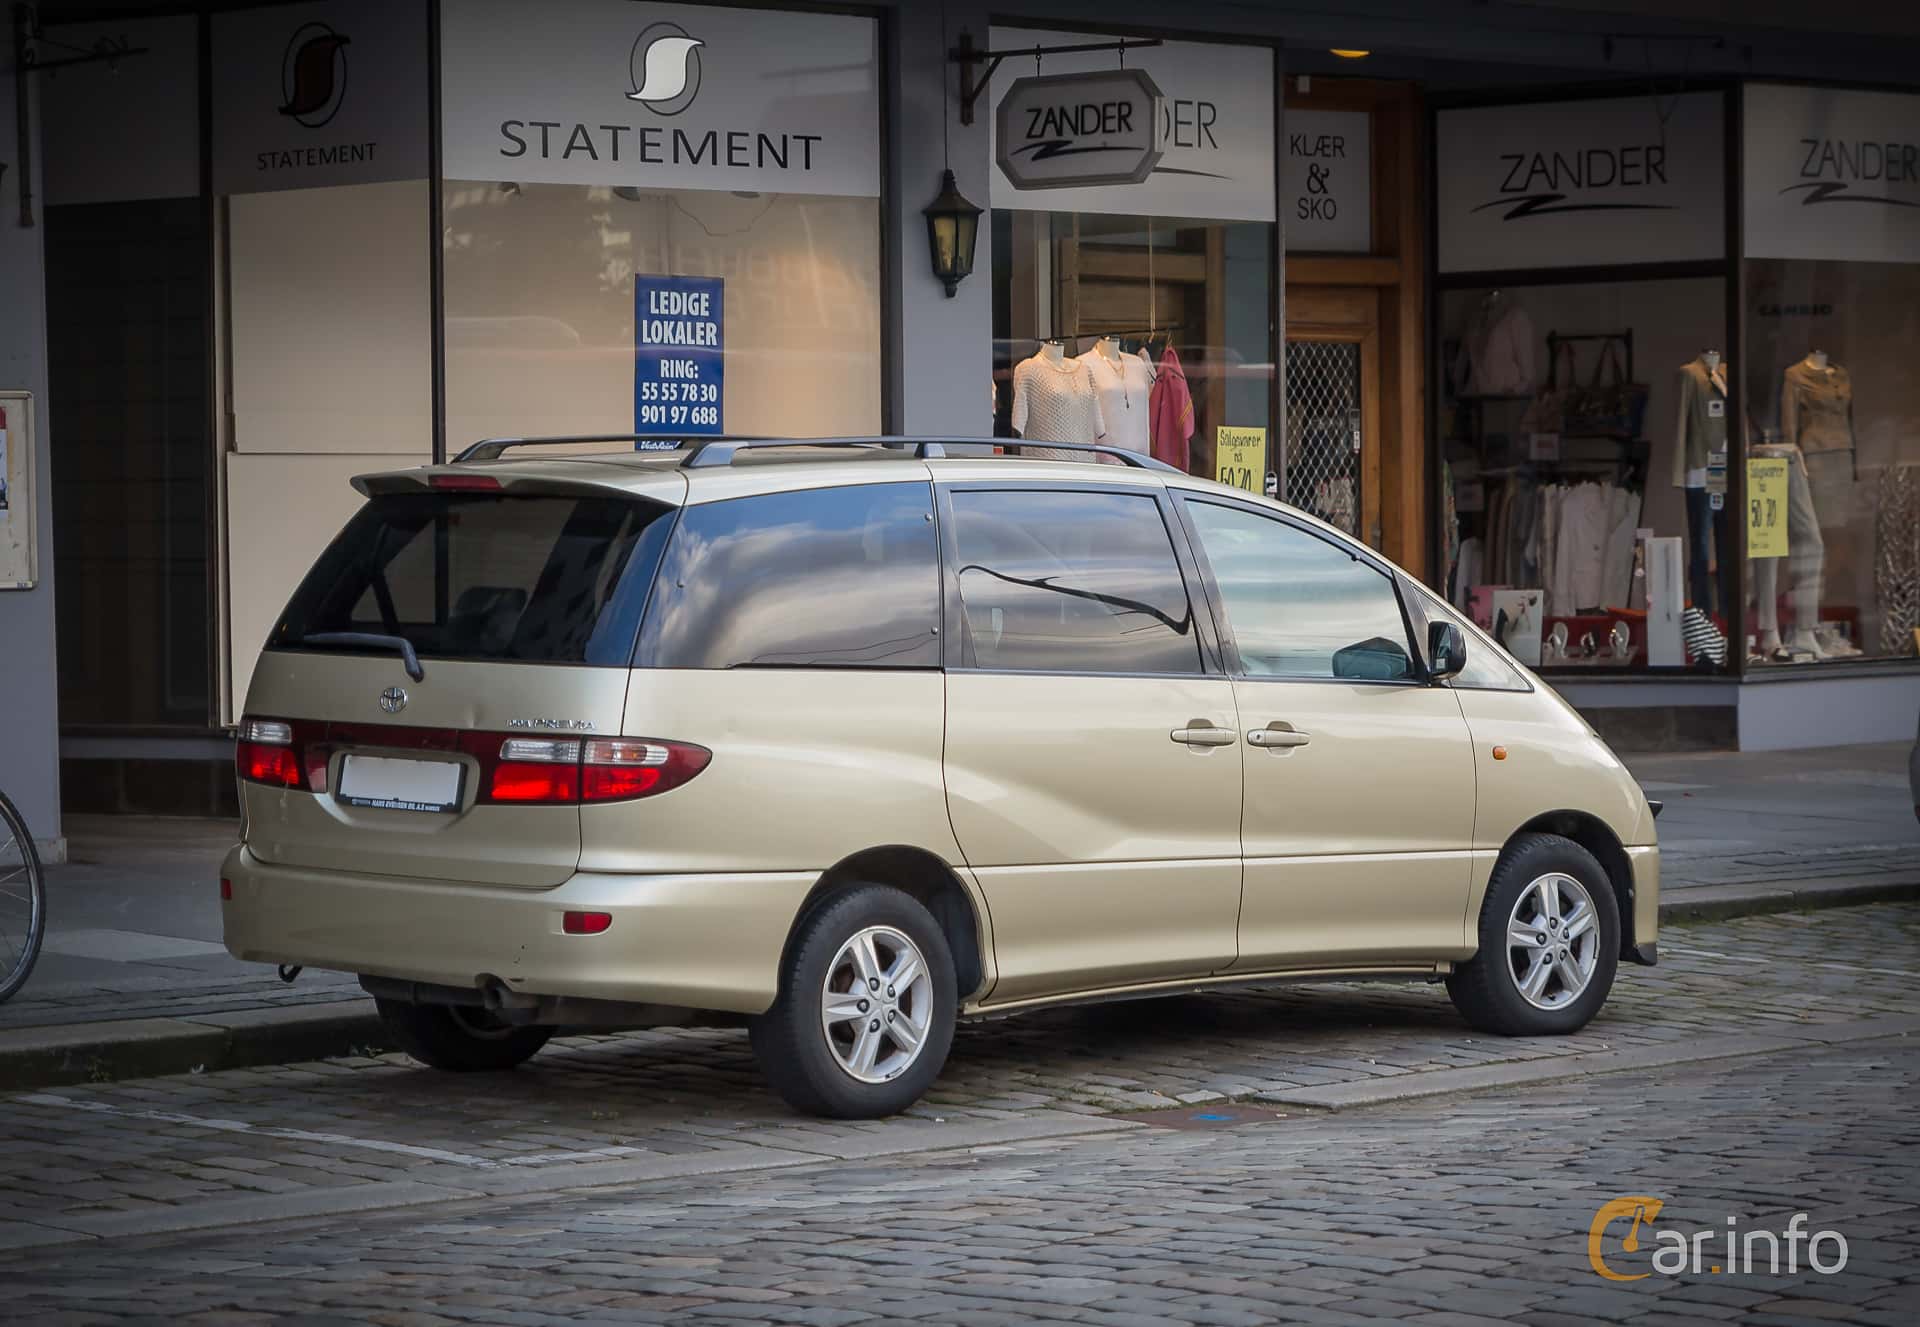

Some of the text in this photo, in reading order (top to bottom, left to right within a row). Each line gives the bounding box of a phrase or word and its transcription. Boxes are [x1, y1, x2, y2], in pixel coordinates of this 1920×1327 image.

[1026, 101, 1134, 140] ZANDER
[257, 142, 377, 171] STATEMENT
[499, 119, 823, 171] STATEMENT
[1290, 134, 1345, 158] KLÆR
[1500, 145, 1668, 193] ZANDER
[1799, 138, 1919, 184] ZANDER
[1306, 162, 1330, 194] &
[1297, 197, 1337, 220] SKO
[649, 290, 710, 317] LEDIGE
[642, 319, 718, 346] LOKALER
[660, 359, 699, 379] RING:
[641, 382, 718, 403] 55 55 78 30
[641, 405, 718, 425] 901 97 688
